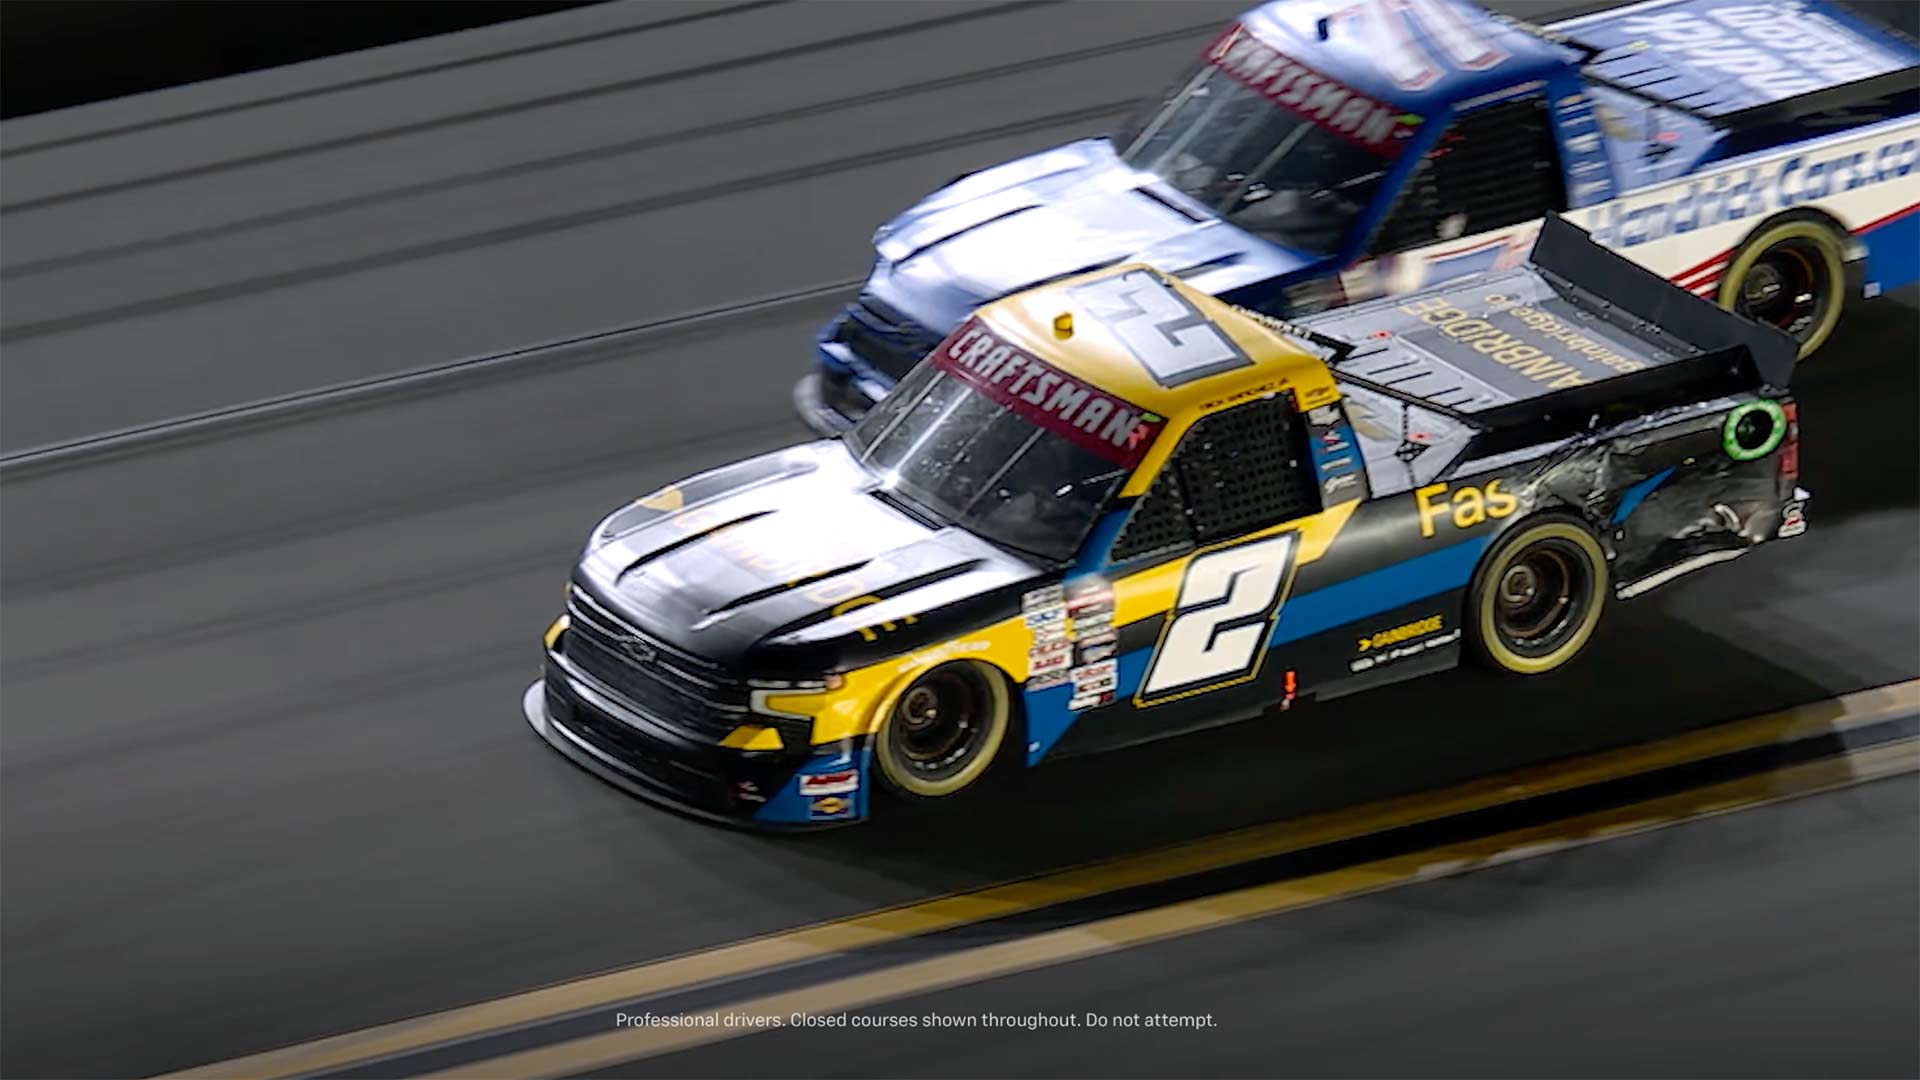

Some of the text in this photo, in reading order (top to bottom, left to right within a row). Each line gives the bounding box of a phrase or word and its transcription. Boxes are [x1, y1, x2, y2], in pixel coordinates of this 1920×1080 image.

[945, 326, 1142, 448] CRAFTSMAN
[1401, 299, 1599, 390] AINBRIDGE
[1141, 533, 1296, 698] 2
